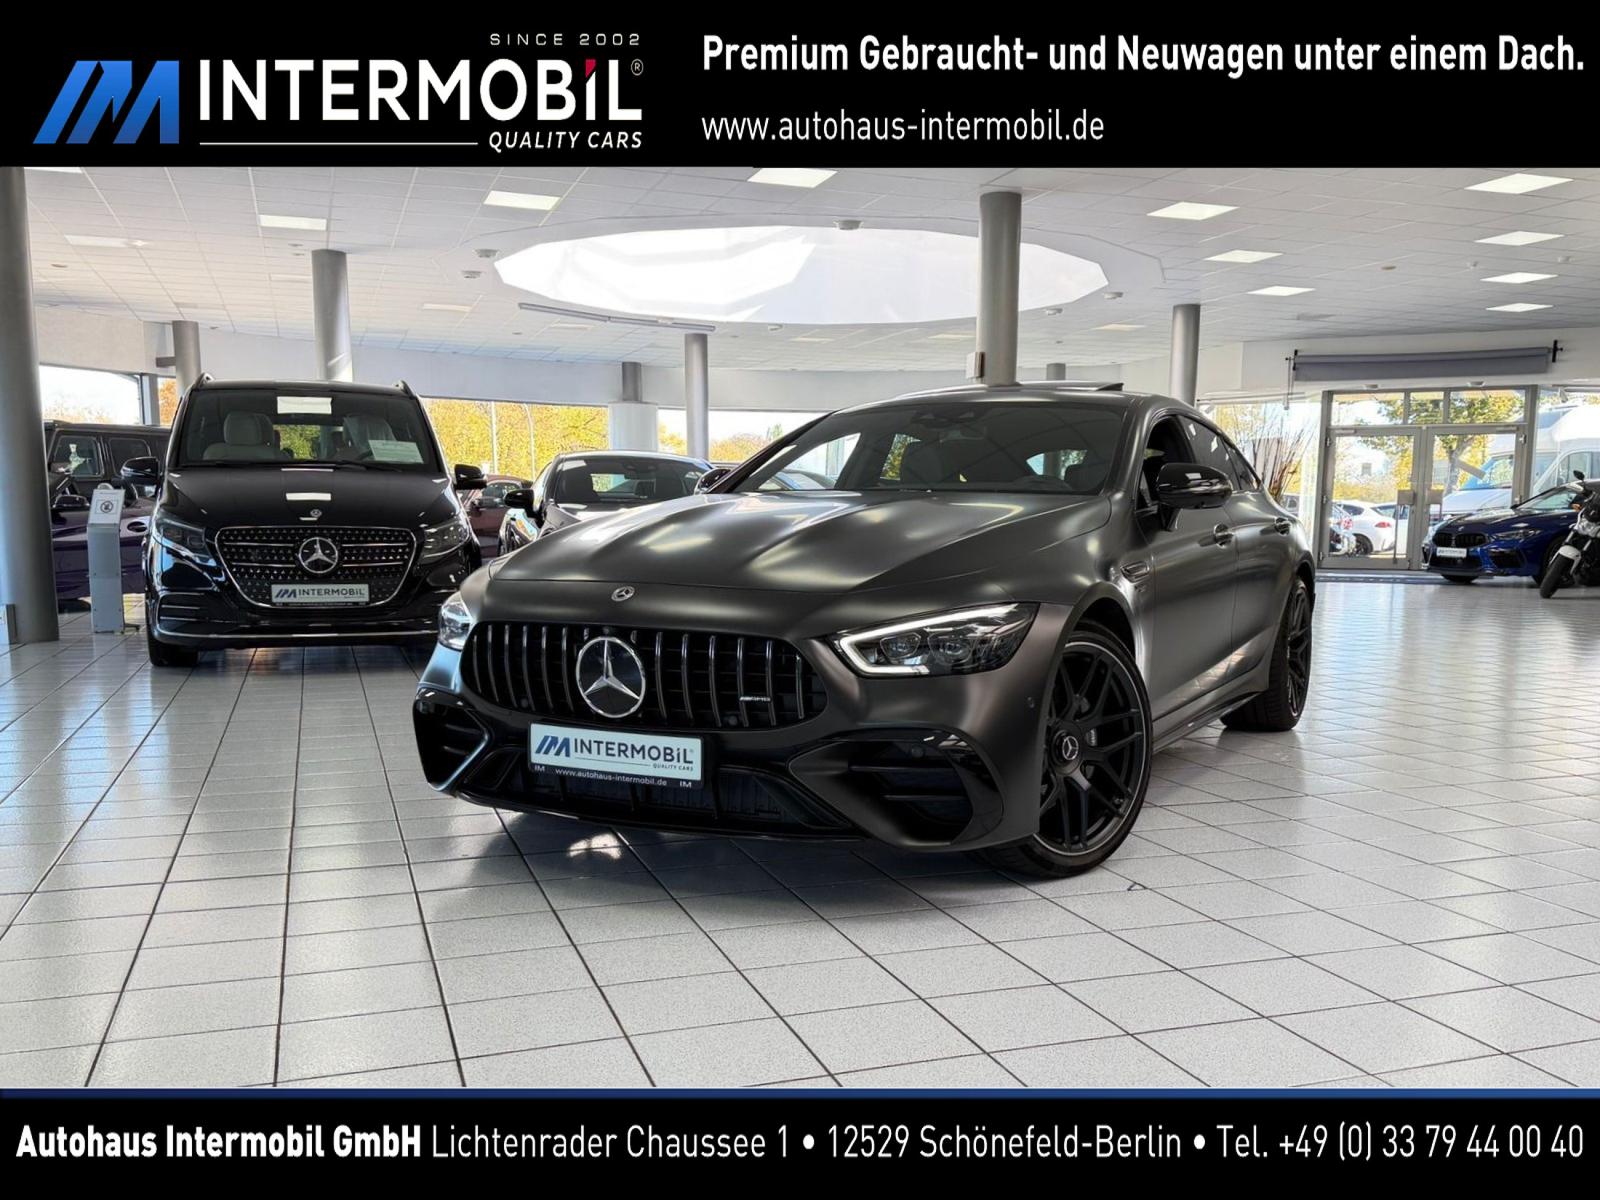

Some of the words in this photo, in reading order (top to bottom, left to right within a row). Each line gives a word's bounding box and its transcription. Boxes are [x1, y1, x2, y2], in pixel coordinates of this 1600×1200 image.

[652, 763, 677, 771] QUALITY
[555, 768, 668, 787] www.autohaus-intermobil.de
[679, 780, 692, 788] IM
